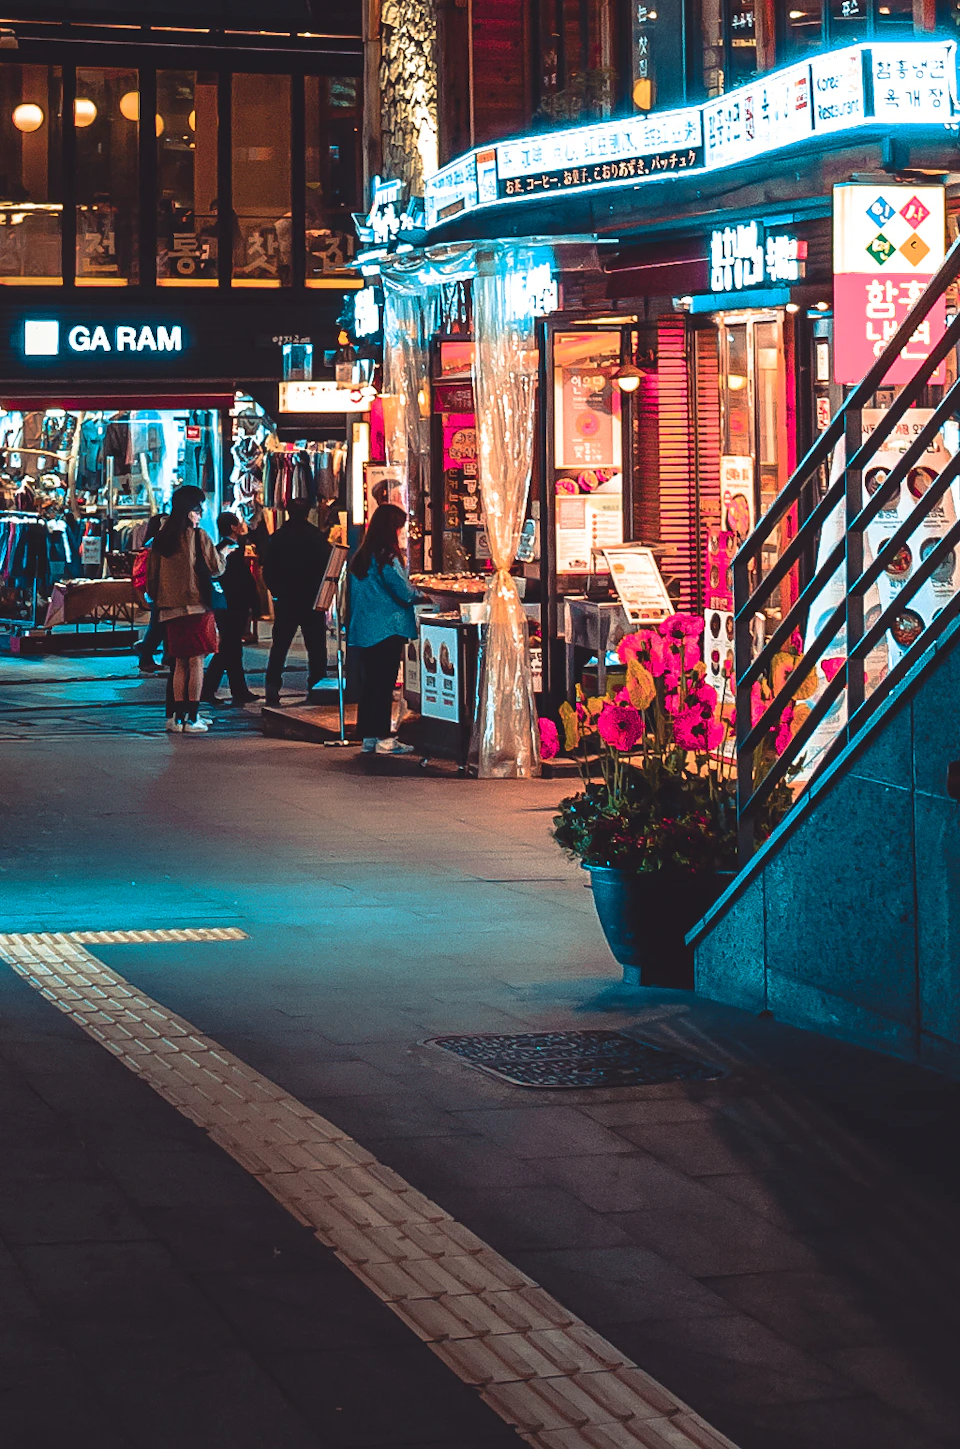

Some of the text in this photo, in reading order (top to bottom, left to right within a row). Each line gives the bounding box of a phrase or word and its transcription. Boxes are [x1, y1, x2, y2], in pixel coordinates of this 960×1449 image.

[876, 59, 945, 80] 함흥냉면
[817, 98, 861, 120] Restaurant
[69, 325, 182, 353] GA RAM
